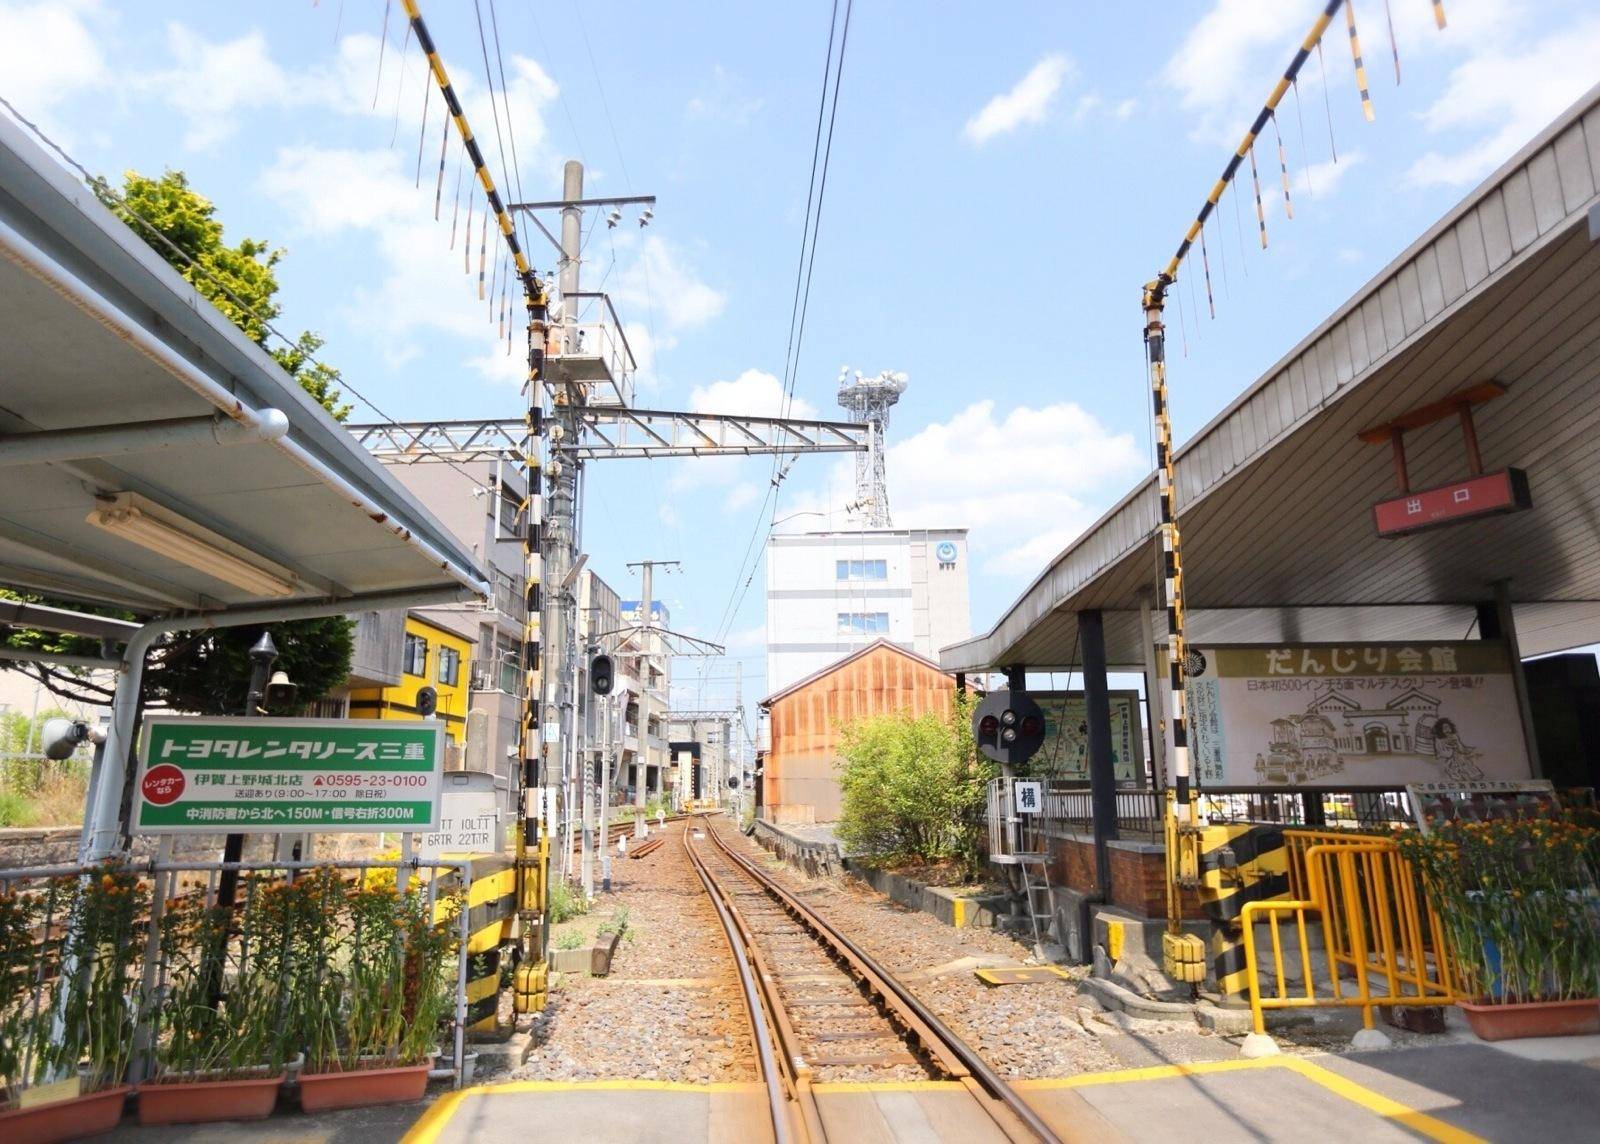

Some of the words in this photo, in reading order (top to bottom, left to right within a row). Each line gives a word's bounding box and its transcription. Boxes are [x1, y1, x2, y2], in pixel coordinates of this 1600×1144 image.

[1407, 488, 1469, 515] 出口
[1265, 646, 1458, 675] だんじり会館
[161, 739, 425, 760] トヨタレンタリース三重
[144, 777, 183, 789] レンタカー
[156, 785, 172, 795] なら
[194, 774, 303, 787] 伊賀上野城北店
[326, 775, 427, 787] 0595-23-0100
[1021, 788, 1035, 807] 構
